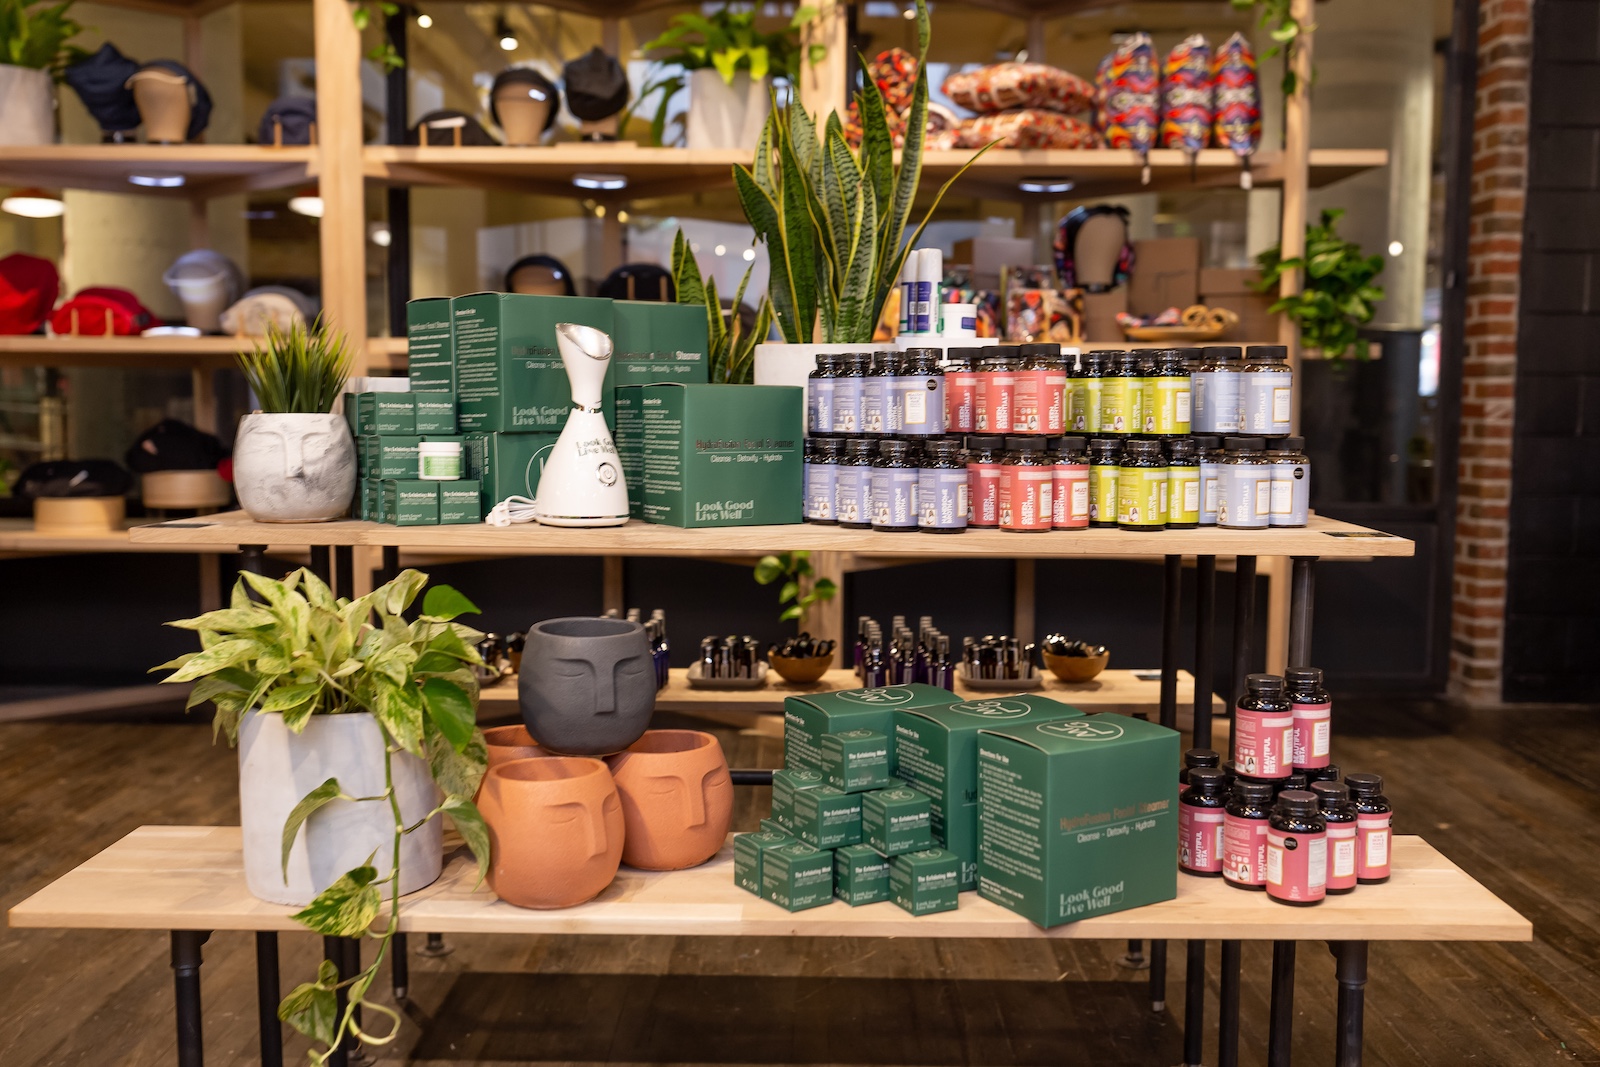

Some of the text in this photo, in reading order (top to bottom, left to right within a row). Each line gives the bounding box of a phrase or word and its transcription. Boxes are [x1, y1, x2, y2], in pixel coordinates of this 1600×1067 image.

[676, 351, 701, 360] Steamer
[512, 406, 568, 416] Look Good
[512, 415, 558, 426] Live Well
[576, 438, 601, 448] Look
[696, 440, 740, 452] HydroFusion
[710, 454, 732, 463] Cleanse
[736, 454, 758, 463] Detoxify
[764, 454, 782, 462] Hydrate
[696, 500, 754, 512] Look Good
[696, 510, 742, 521] Live Well
[1263, 737, 1271, 774] BEAUTIFUL
[832, 808, 850, 817] Exfoliating
[899, 814, 918, 824] Exfoliating
[1060, 812, 1110, 832] HydroFusion
[1077, 832, 1100, 844] Cleanse
[1106, 826, 1130, 838] Detoxify
[1135, 820, 1156, 832] Hydrate
[962, 862, 978, 872] Lo
[803, 869, 822, 878] Exfoliating
[926, 874, 946, 882] Exfoliating
[1060, 881, 1124, 906] Look Good
[1060, 896, 1111, 917] Live Well
